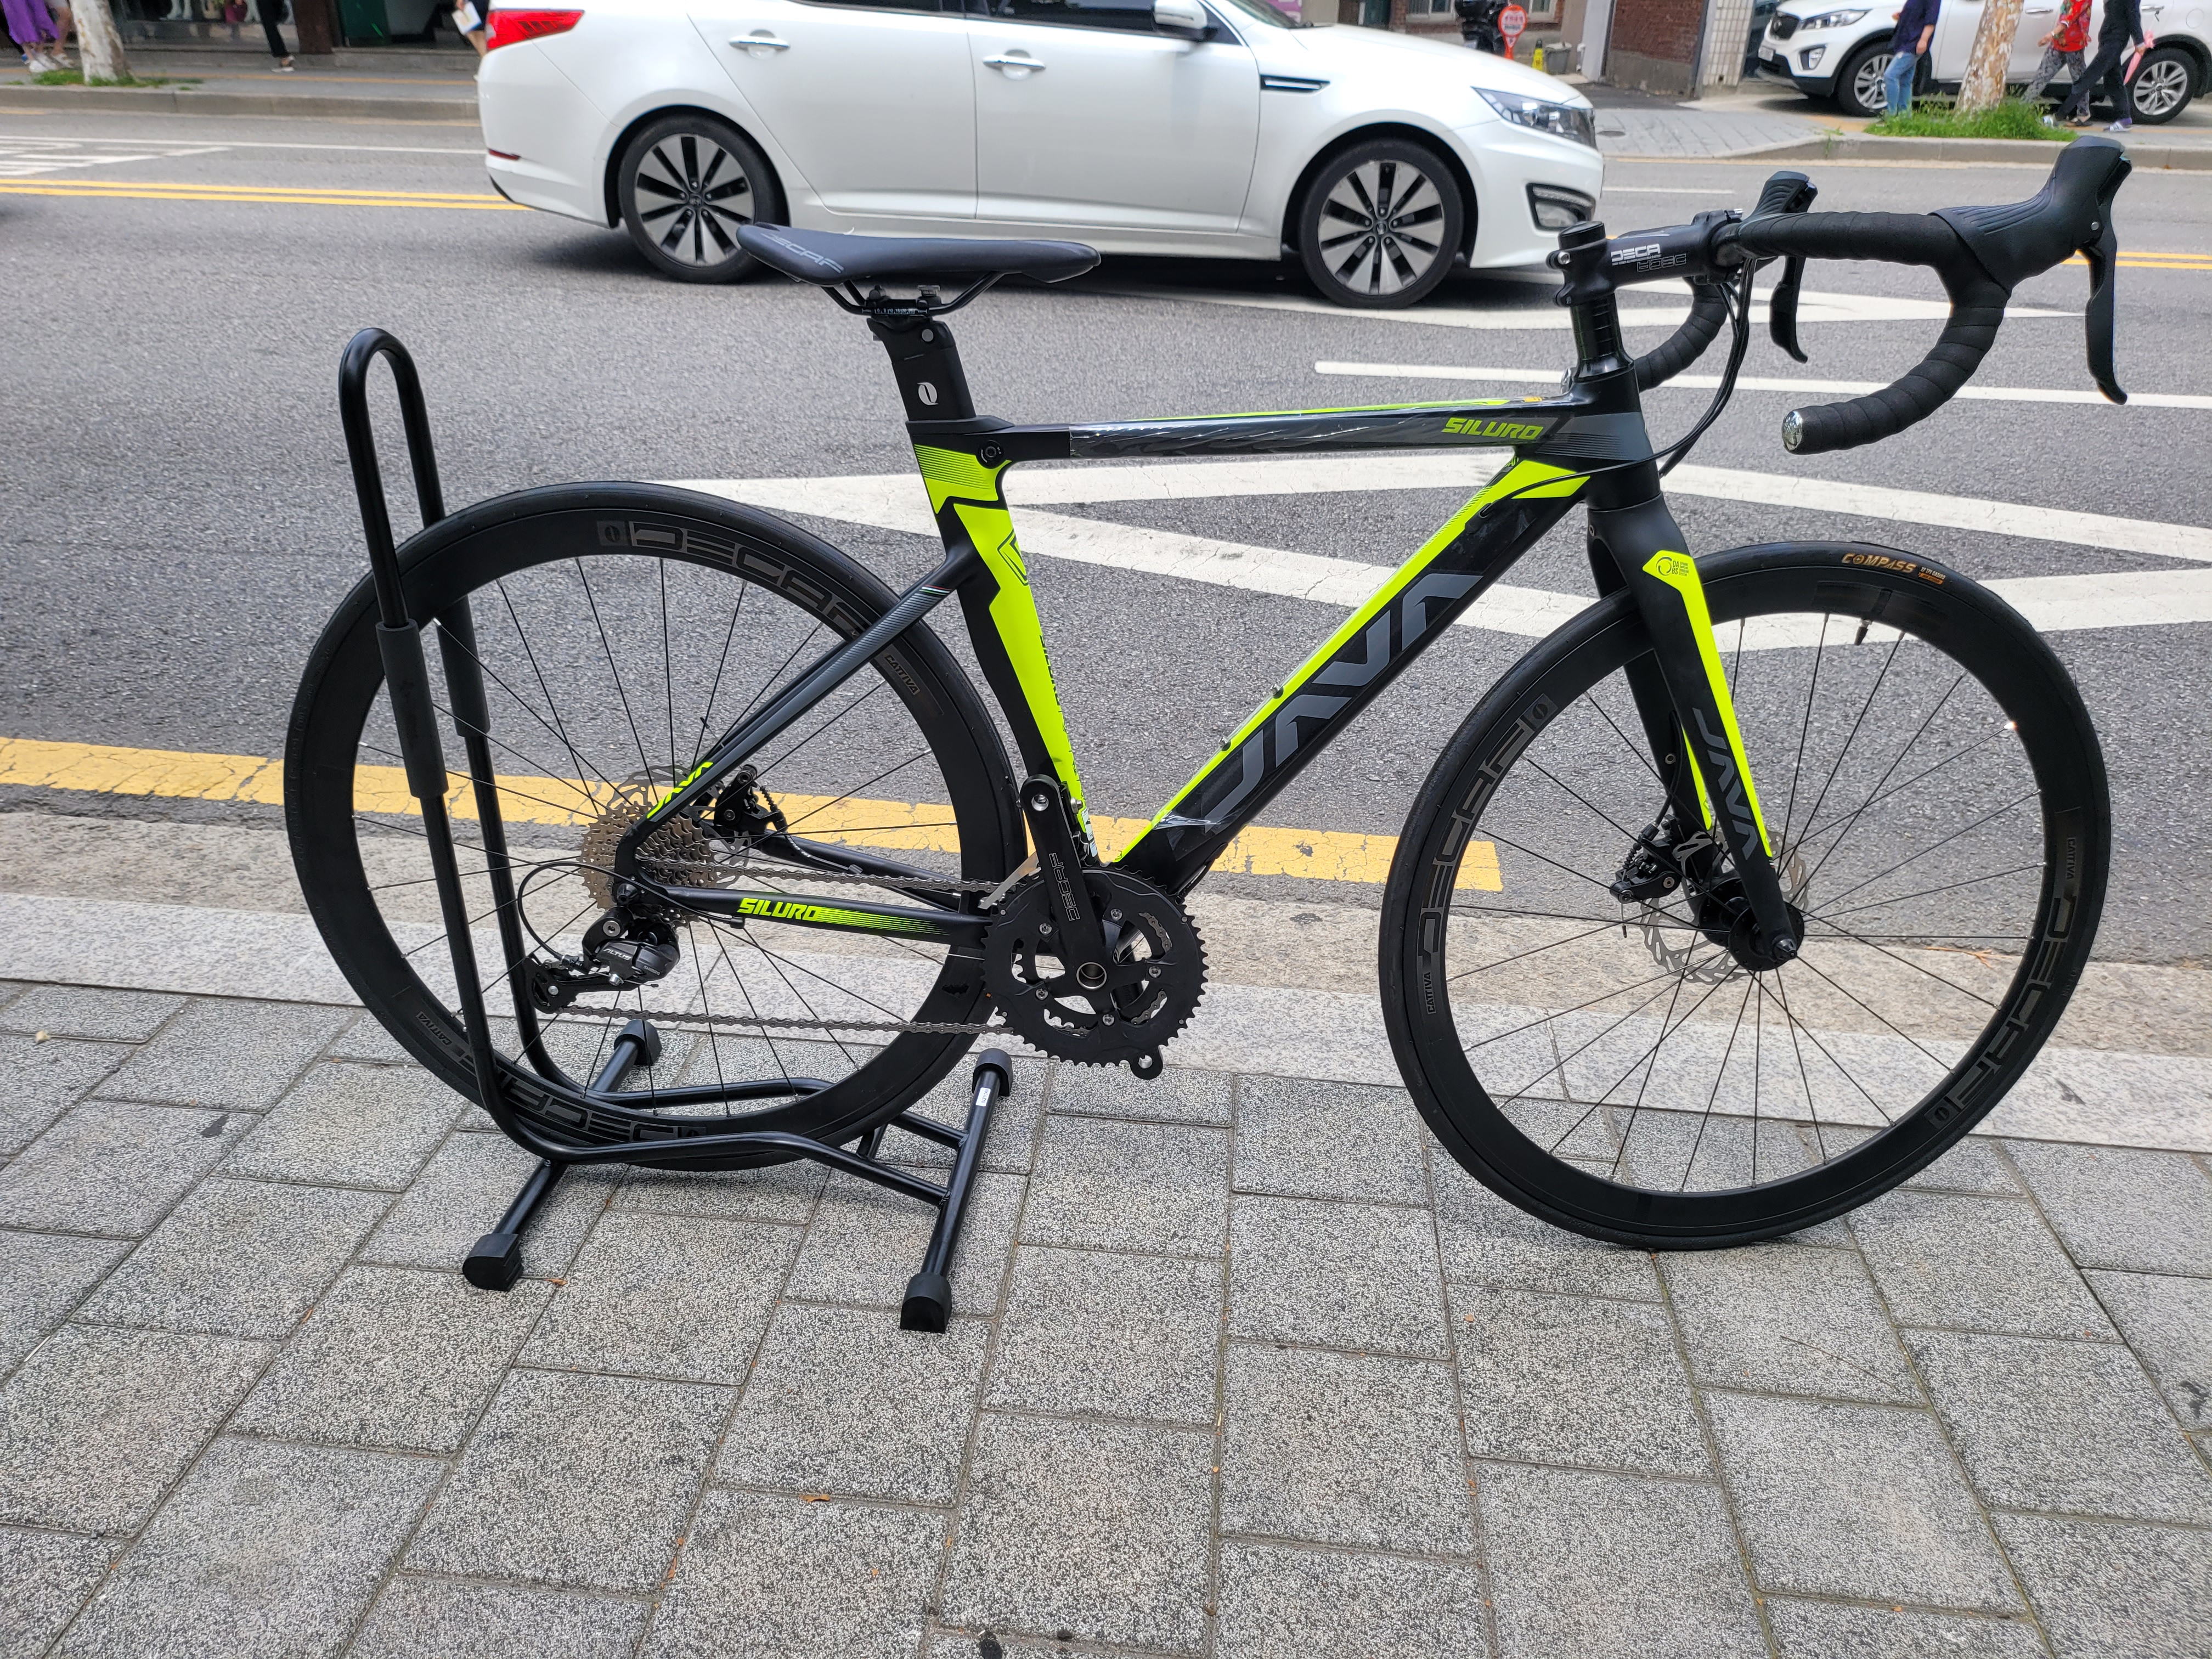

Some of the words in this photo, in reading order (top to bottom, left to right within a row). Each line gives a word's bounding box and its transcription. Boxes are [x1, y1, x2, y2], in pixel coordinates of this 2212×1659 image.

[1611, 244, 1661, 262] DECA
[1441, 417, 1544, 440] SILURO
[1841, 552, 1917, 574] COMPASS
[884, 654, 918, 693] CATTIVA
[1204, 572, 1485, 834] JAVA
[646, 761, 714, 819] JAVA
[1692, 707, 1758, 861] JAVA
[1417, 720, 1527, 957] DECAF
[2066, 836, 2076, 881] CATTIVA
[1048, 852, 1081, 922] DECAF
[736, 897, 823, 922] SILURO
[603, 948, 633, 961] ALTUS
[1423, 971, 1436, 1014] CATTIVA
[418, 1013, 453, 1046] CATTIVA
